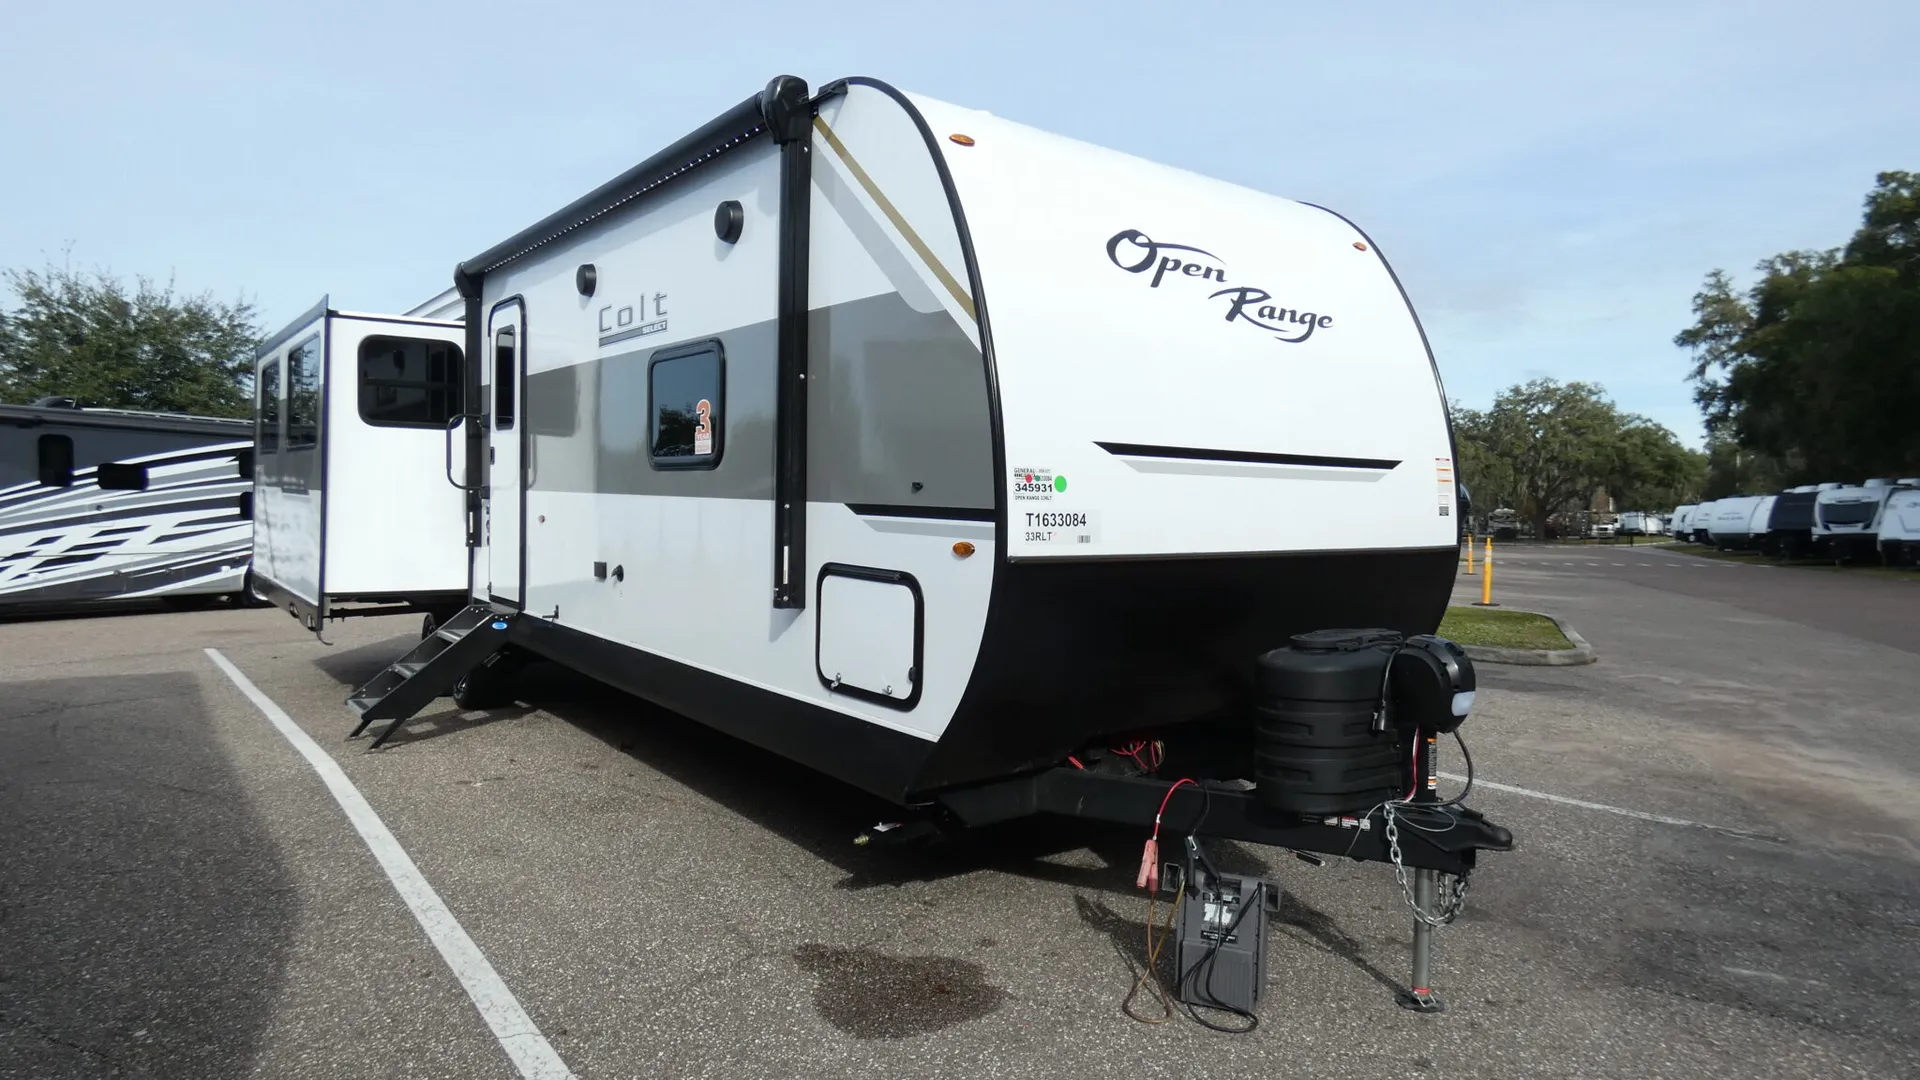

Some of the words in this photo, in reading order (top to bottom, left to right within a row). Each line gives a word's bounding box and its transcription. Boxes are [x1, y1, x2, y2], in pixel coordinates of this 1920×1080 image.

[1106, 229, 1228, 288] Open
[599, 293, 668, 333] Colt
[1208, 286, 1334, 343] Range
[642, 321, 667, 334] SELECT
[696, 399, 711, 434] 3
[1015, 483, 1052, 492] 345931
[1026, 513, 1086, 526] T1633084
[1025, 532, 1052, 541] 33RLT
